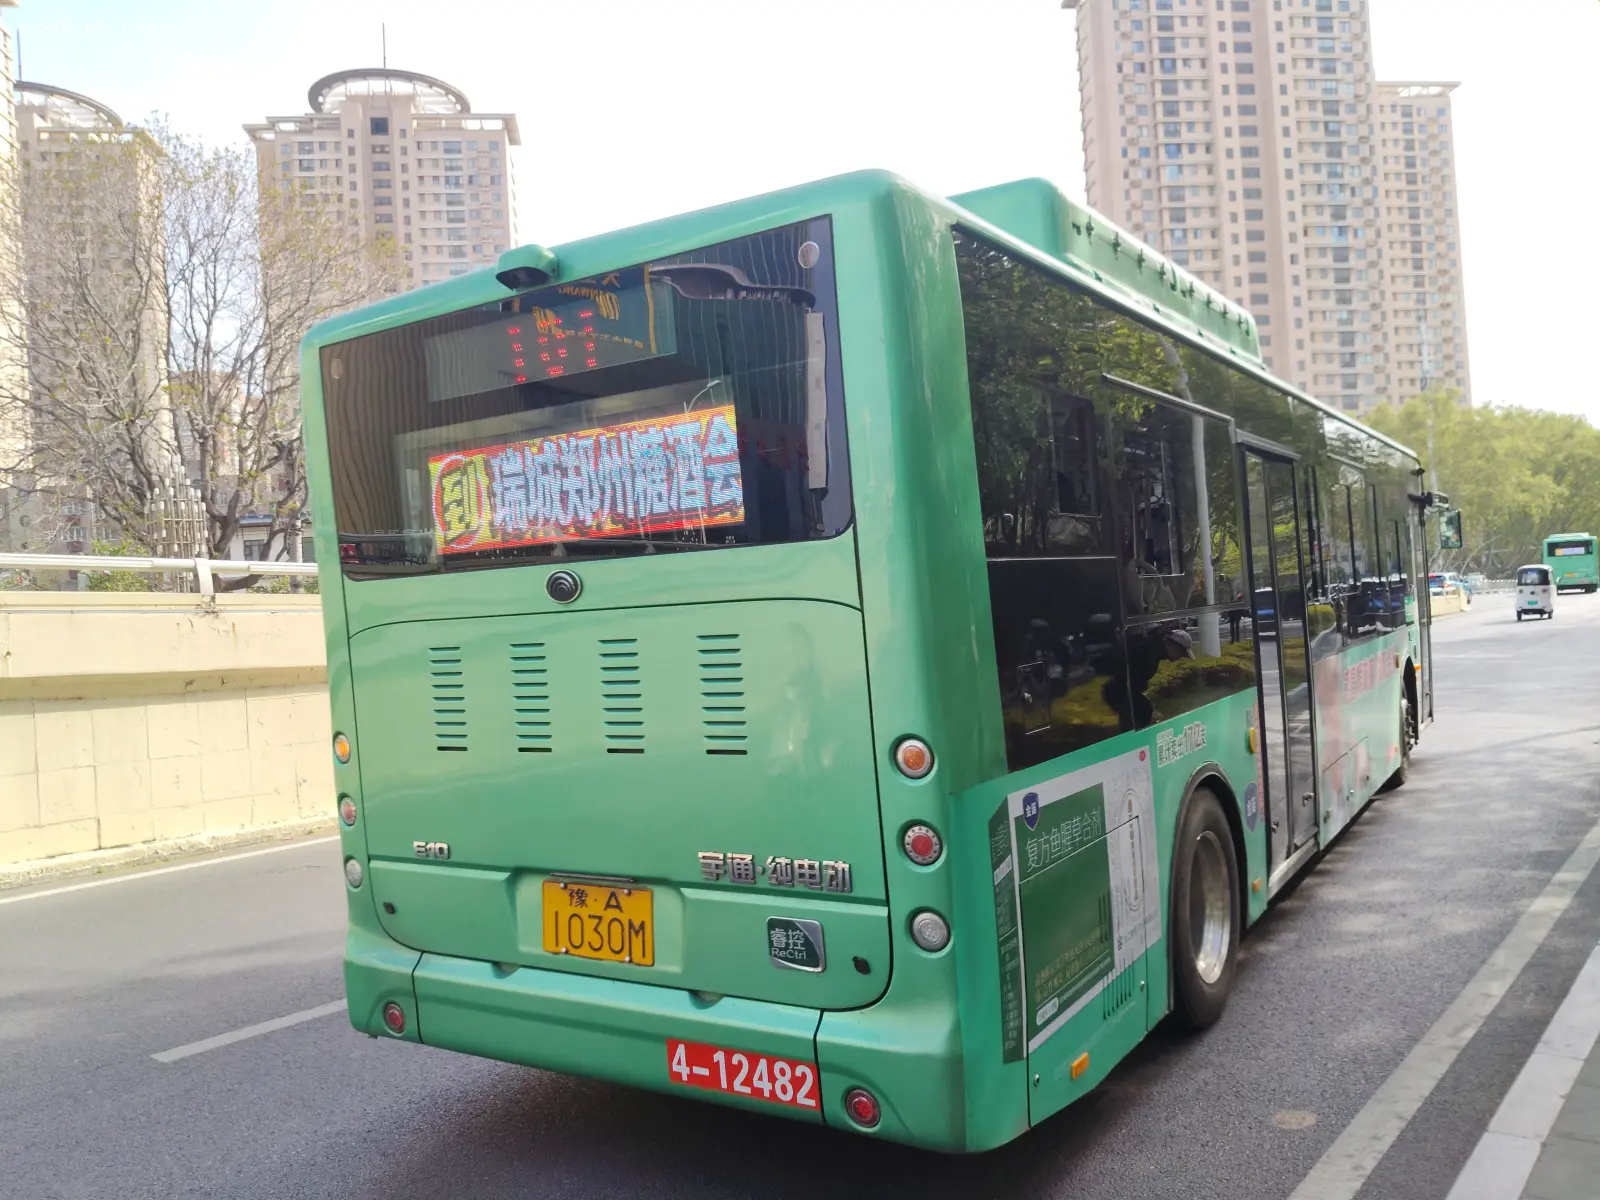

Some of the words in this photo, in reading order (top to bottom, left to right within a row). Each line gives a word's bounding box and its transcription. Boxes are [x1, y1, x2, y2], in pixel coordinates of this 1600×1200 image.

[442, 461, 485, 543] 到
[413, 840, 450, 860] E10
[1026, 807, 1102, 872] 复方鱼腥草合剂
[554, 910, 646, 960] 1030M
[770, 928, 805, 950] 睿控
[771, 947, 807, 960] ReCtrl
[672, 1043, 816, 1107] 4-12482
